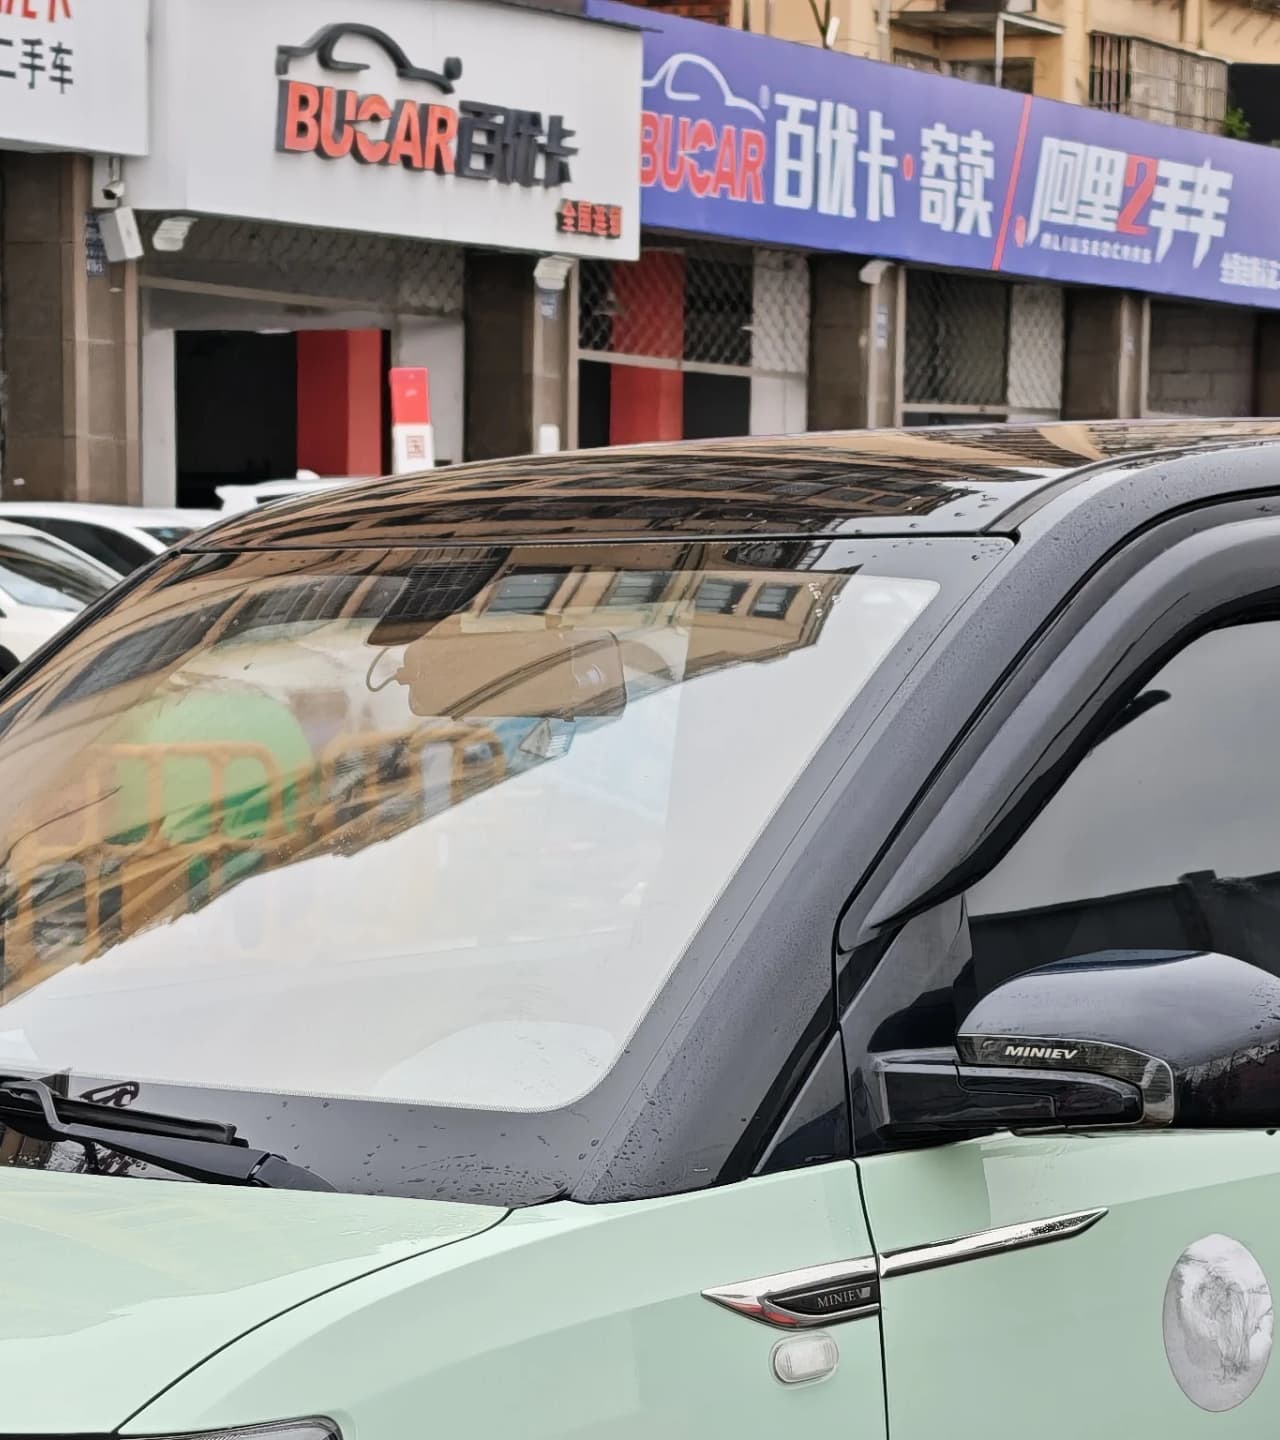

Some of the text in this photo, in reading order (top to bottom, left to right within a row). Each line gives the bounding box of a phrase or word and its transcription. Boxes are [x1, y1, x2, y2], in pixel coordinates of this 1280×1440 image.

[278, 79, 459, 176] BUCAR
[639, 109, 767, 204] BUCAR
[1005, 1045, 1078, 1060] MINIEV
[817, 1287, 867, 1309] MINIEV
